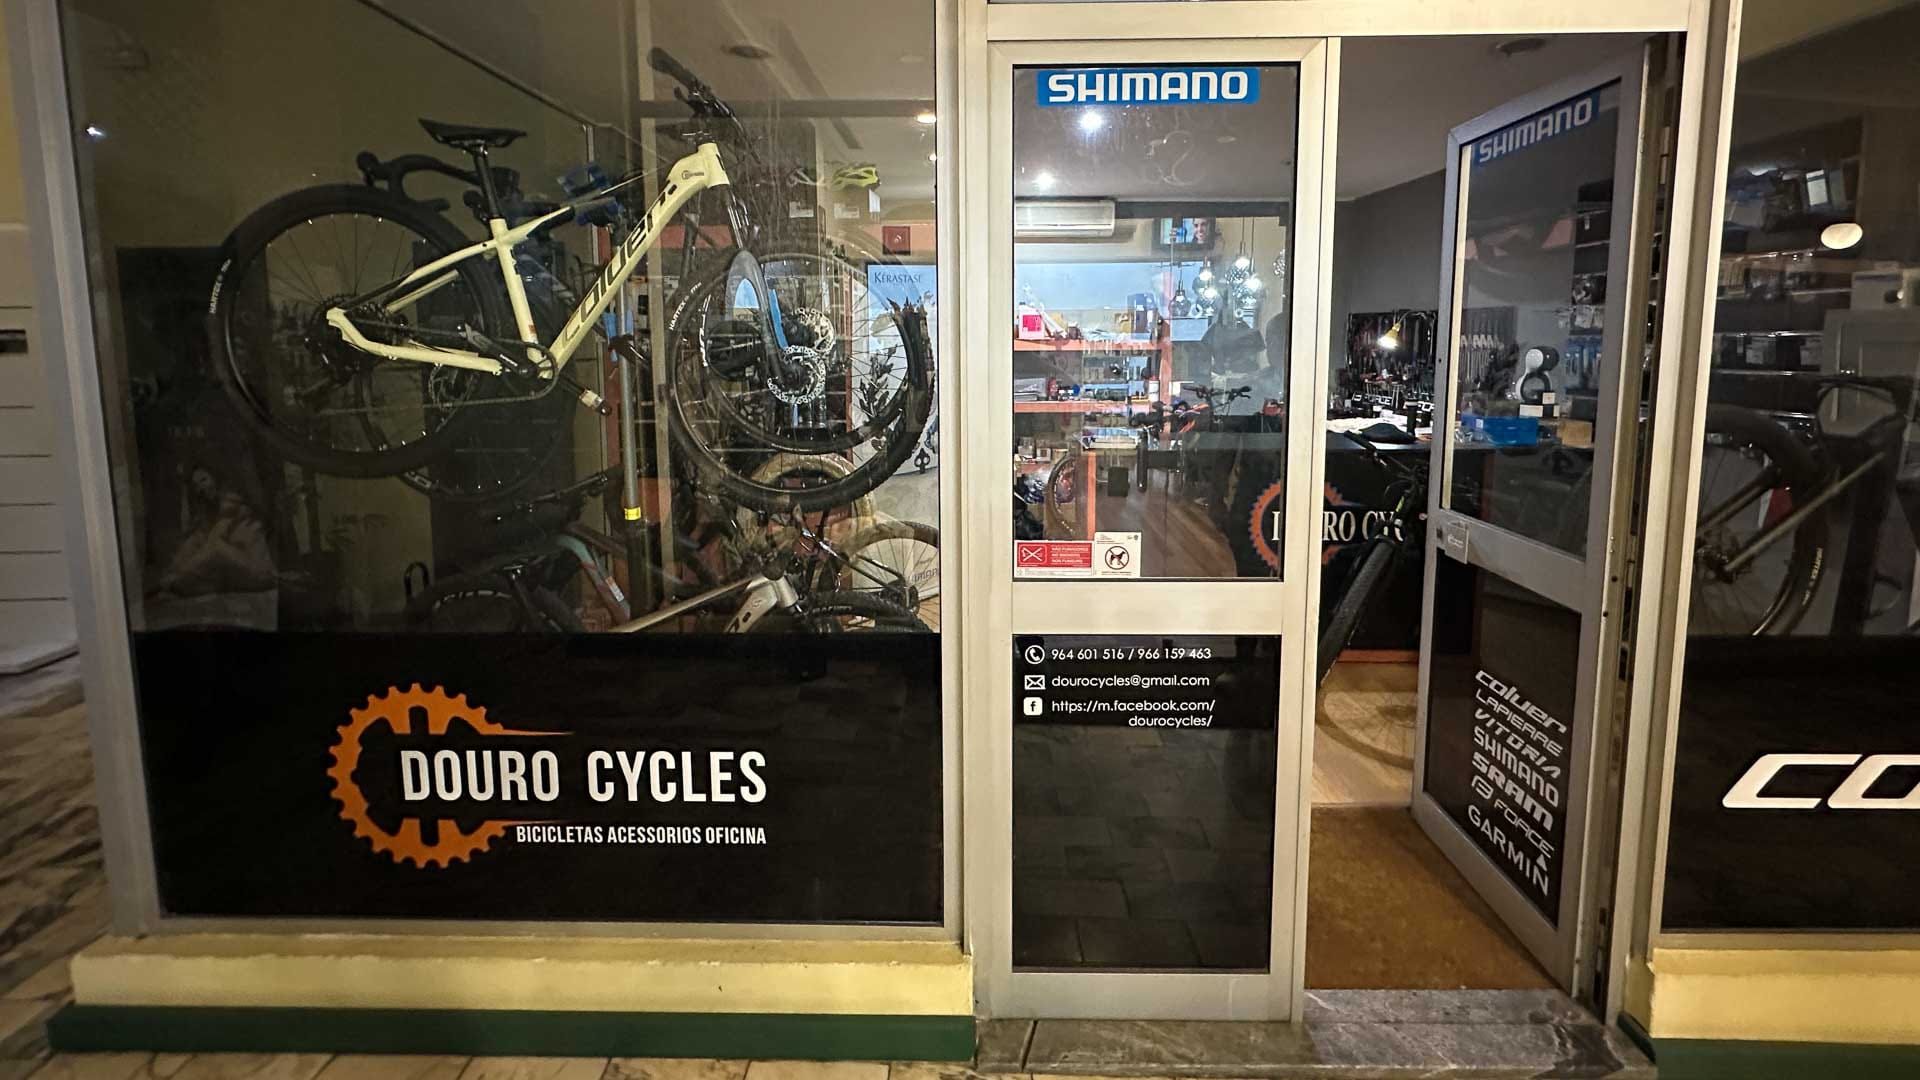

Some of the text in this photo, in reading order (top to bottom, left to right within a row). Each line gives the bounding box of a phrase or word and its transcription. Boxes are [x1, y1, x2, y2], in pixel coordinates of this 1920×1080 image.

[1048, 71, 1248, 103] SHIMANO
[1479, 97, 1593, 163] SHIMANO
[1051, 649, 1074, 660] 964
[1077, 649, 1098, 660] 601
[1102, 649, 1125, 660] 516
[1137, 649, 1160, 660] 966
[1165, 648, 1184, 660] 159
[1188, 648, 1212, 660] 463
[1051, 675, 1210, 688] dourocycles@gmail.com
[1051, 700, 1216, 714] https://m.facebook.com/
[1128, 715, 1213, 728] dourocycles/
[1475, 688, 1563, 757] LAPIERRE
[400, 750, 767, 802] DOURO CYCLES
[1472, 752, 1554, 832] SRAM
[1473, 726, 1559, 808] SHIMANO
[516, 826, 767, 844] BICICLETAS ACESSORIOS OFICINA
[1467, 804, 1549, 897] GARMIN
[1494, 799, 1555, 859] FORCE
